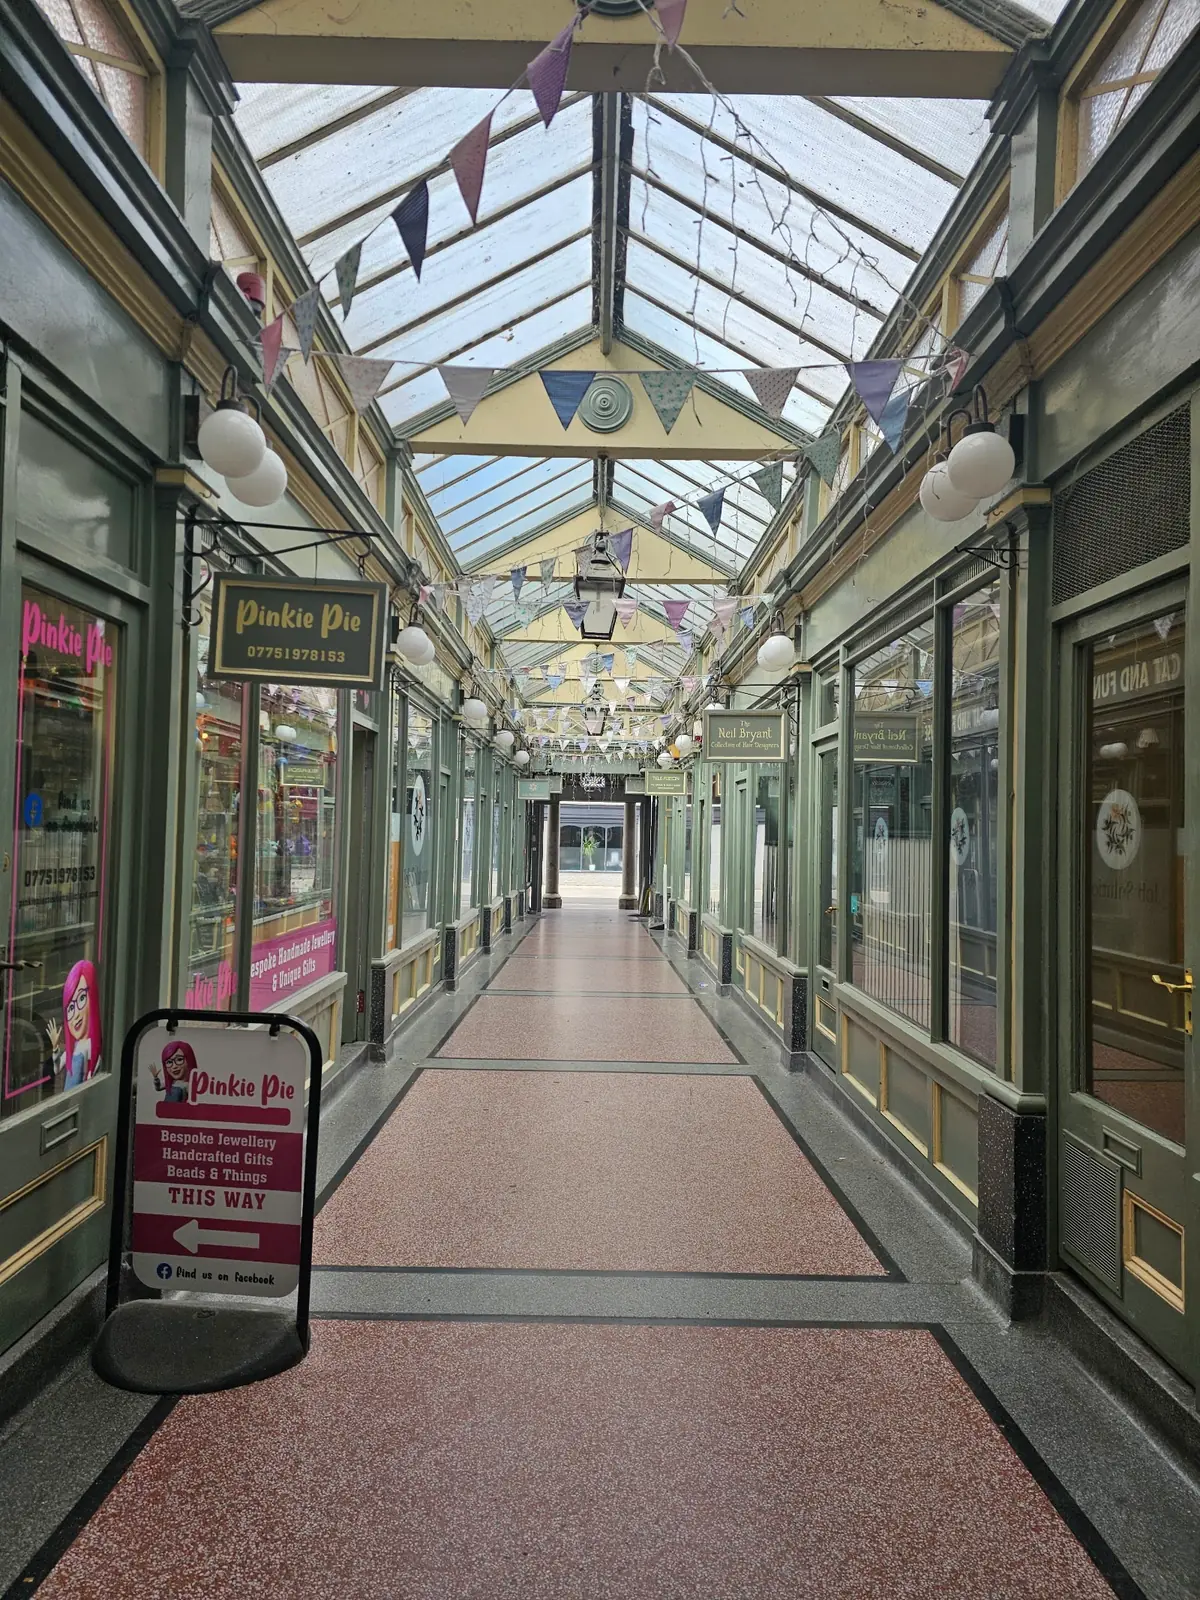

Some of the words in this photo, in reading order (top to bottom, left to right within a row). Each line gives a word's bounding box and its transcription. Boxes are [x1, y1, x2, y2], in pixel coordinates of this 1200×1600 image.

[236, 600, 314, 634] Pinkie
[321, 603, 361, 639] Pie
[22, 600, 82, 657] Pinkie
[86, 623, 112, 673] Pie
[247, 646, 346, 663] 07751978153
[740, 720, 750, 728] The
[719, 728, 736, 738] Neil
[739, 727, 773, 743] Bryant
[754, 741, 780, 750] Designers
[24, 865, 95, 887] 07751978153
[250, 952, 276, 979] espoke
[278, 938, 311, 965] Handmade
[311, 930, 335, 951] Jewellery
[272, 974, 278, 992] &
[279, 966, 302, 989] Unique
[302, 957, 316, 977] Gifts
[191, 1071, 255, 1102] Pinkie
[261, 1074, 295, 1106] Pie
[161, 1130, 214, 1146] Bespoke
[217, 1133, 277, 1151] Jewellery
[162, 1147, 240, 1164] Handcrafted
[244, 1152, 274, 1166] Gifts
[167, 1165, 206, 1180] Beads
[209, 1168, 219, 1180] &
[222, 1169, 268, 1185] Things
[168, 1187, 216, 1207] THIS
[223, 1191, 266, 1210] WAY
[176, 1266, 197, 1279] find
[202, 1272, 213, 1280] us
[234, 1271, 275, 1286] facebook
